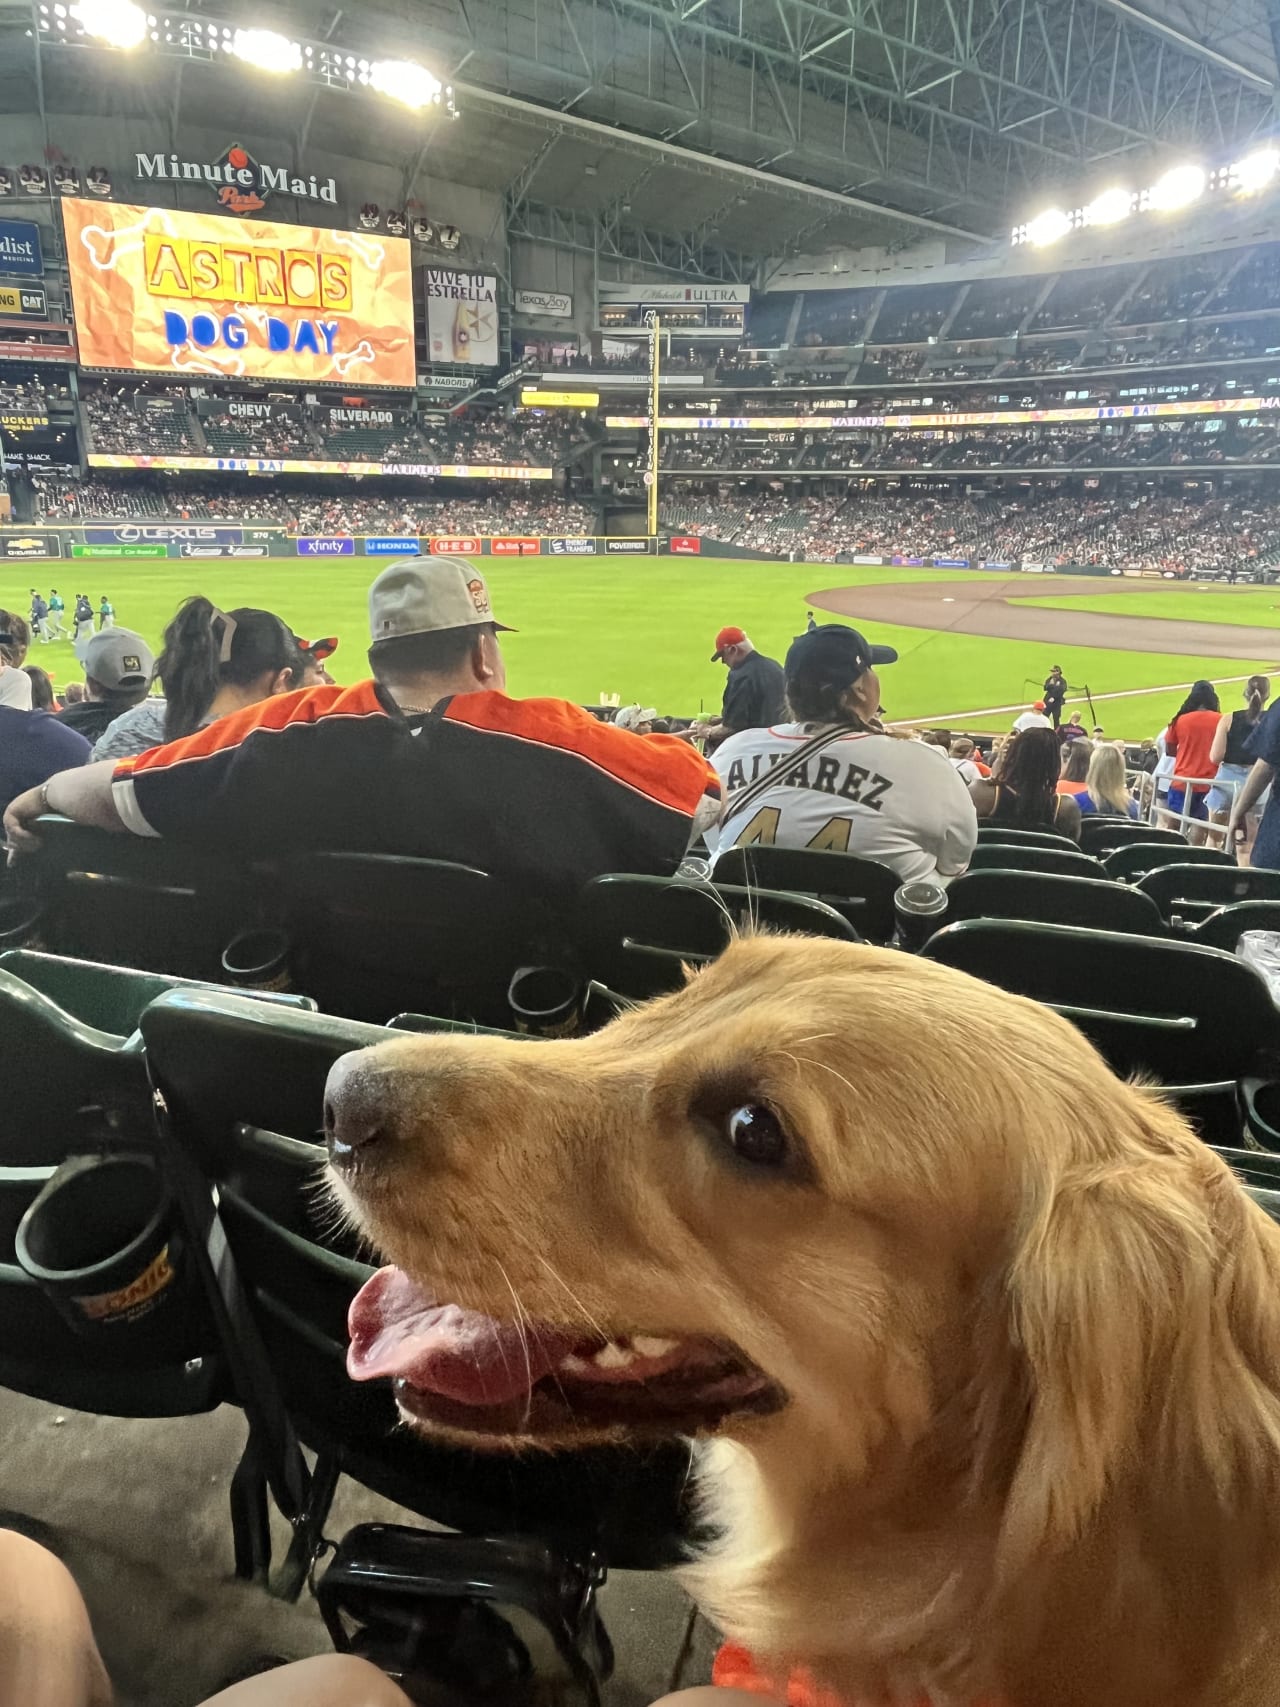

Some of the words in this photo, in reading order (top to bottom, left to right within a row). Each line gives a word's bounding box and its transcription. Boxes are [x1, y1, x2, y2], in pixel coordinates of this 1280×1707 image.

[135, 153, 254, 185] Minute
[259, 164, 338, 204] Maid
[150, 243, 348, 300] ASTROS
[427, 270, 465, 286] VIVE
[468, 275, 485, 288] TU
[427, 284, 493, 303] ESTRELLA
[693, 289, 737, 301] ULTRA
[22, 295, 42, 308] CAT
[164, 308, 250, 350] DOG
[267, 316, 339, 355] DAY
[434, 378, 467, 387] NABORS
[229, 403, 271, 417] CHEVY
[329, 409, 393, 423] SILVERADO
[1098, 407, 1124, 419] DOG
[0, 416, 49, 425] UCKERS
[831, 416, 885, 427] MARINERS
[26, 453, 51, 461] SHACK
[217, 459, 247, 470] DOG
[257, 460, 284, 472] DAY
[381, 463, 442, 476] MARINERS
[142, 527, 217, 540] LEXUS
[308, 539, 344, 553] xfinity
[376, 542, 418, 550] HONDA
[565, 538, 588, 546] ENERGY
[565, 545, 594, 553] TRANSFER
